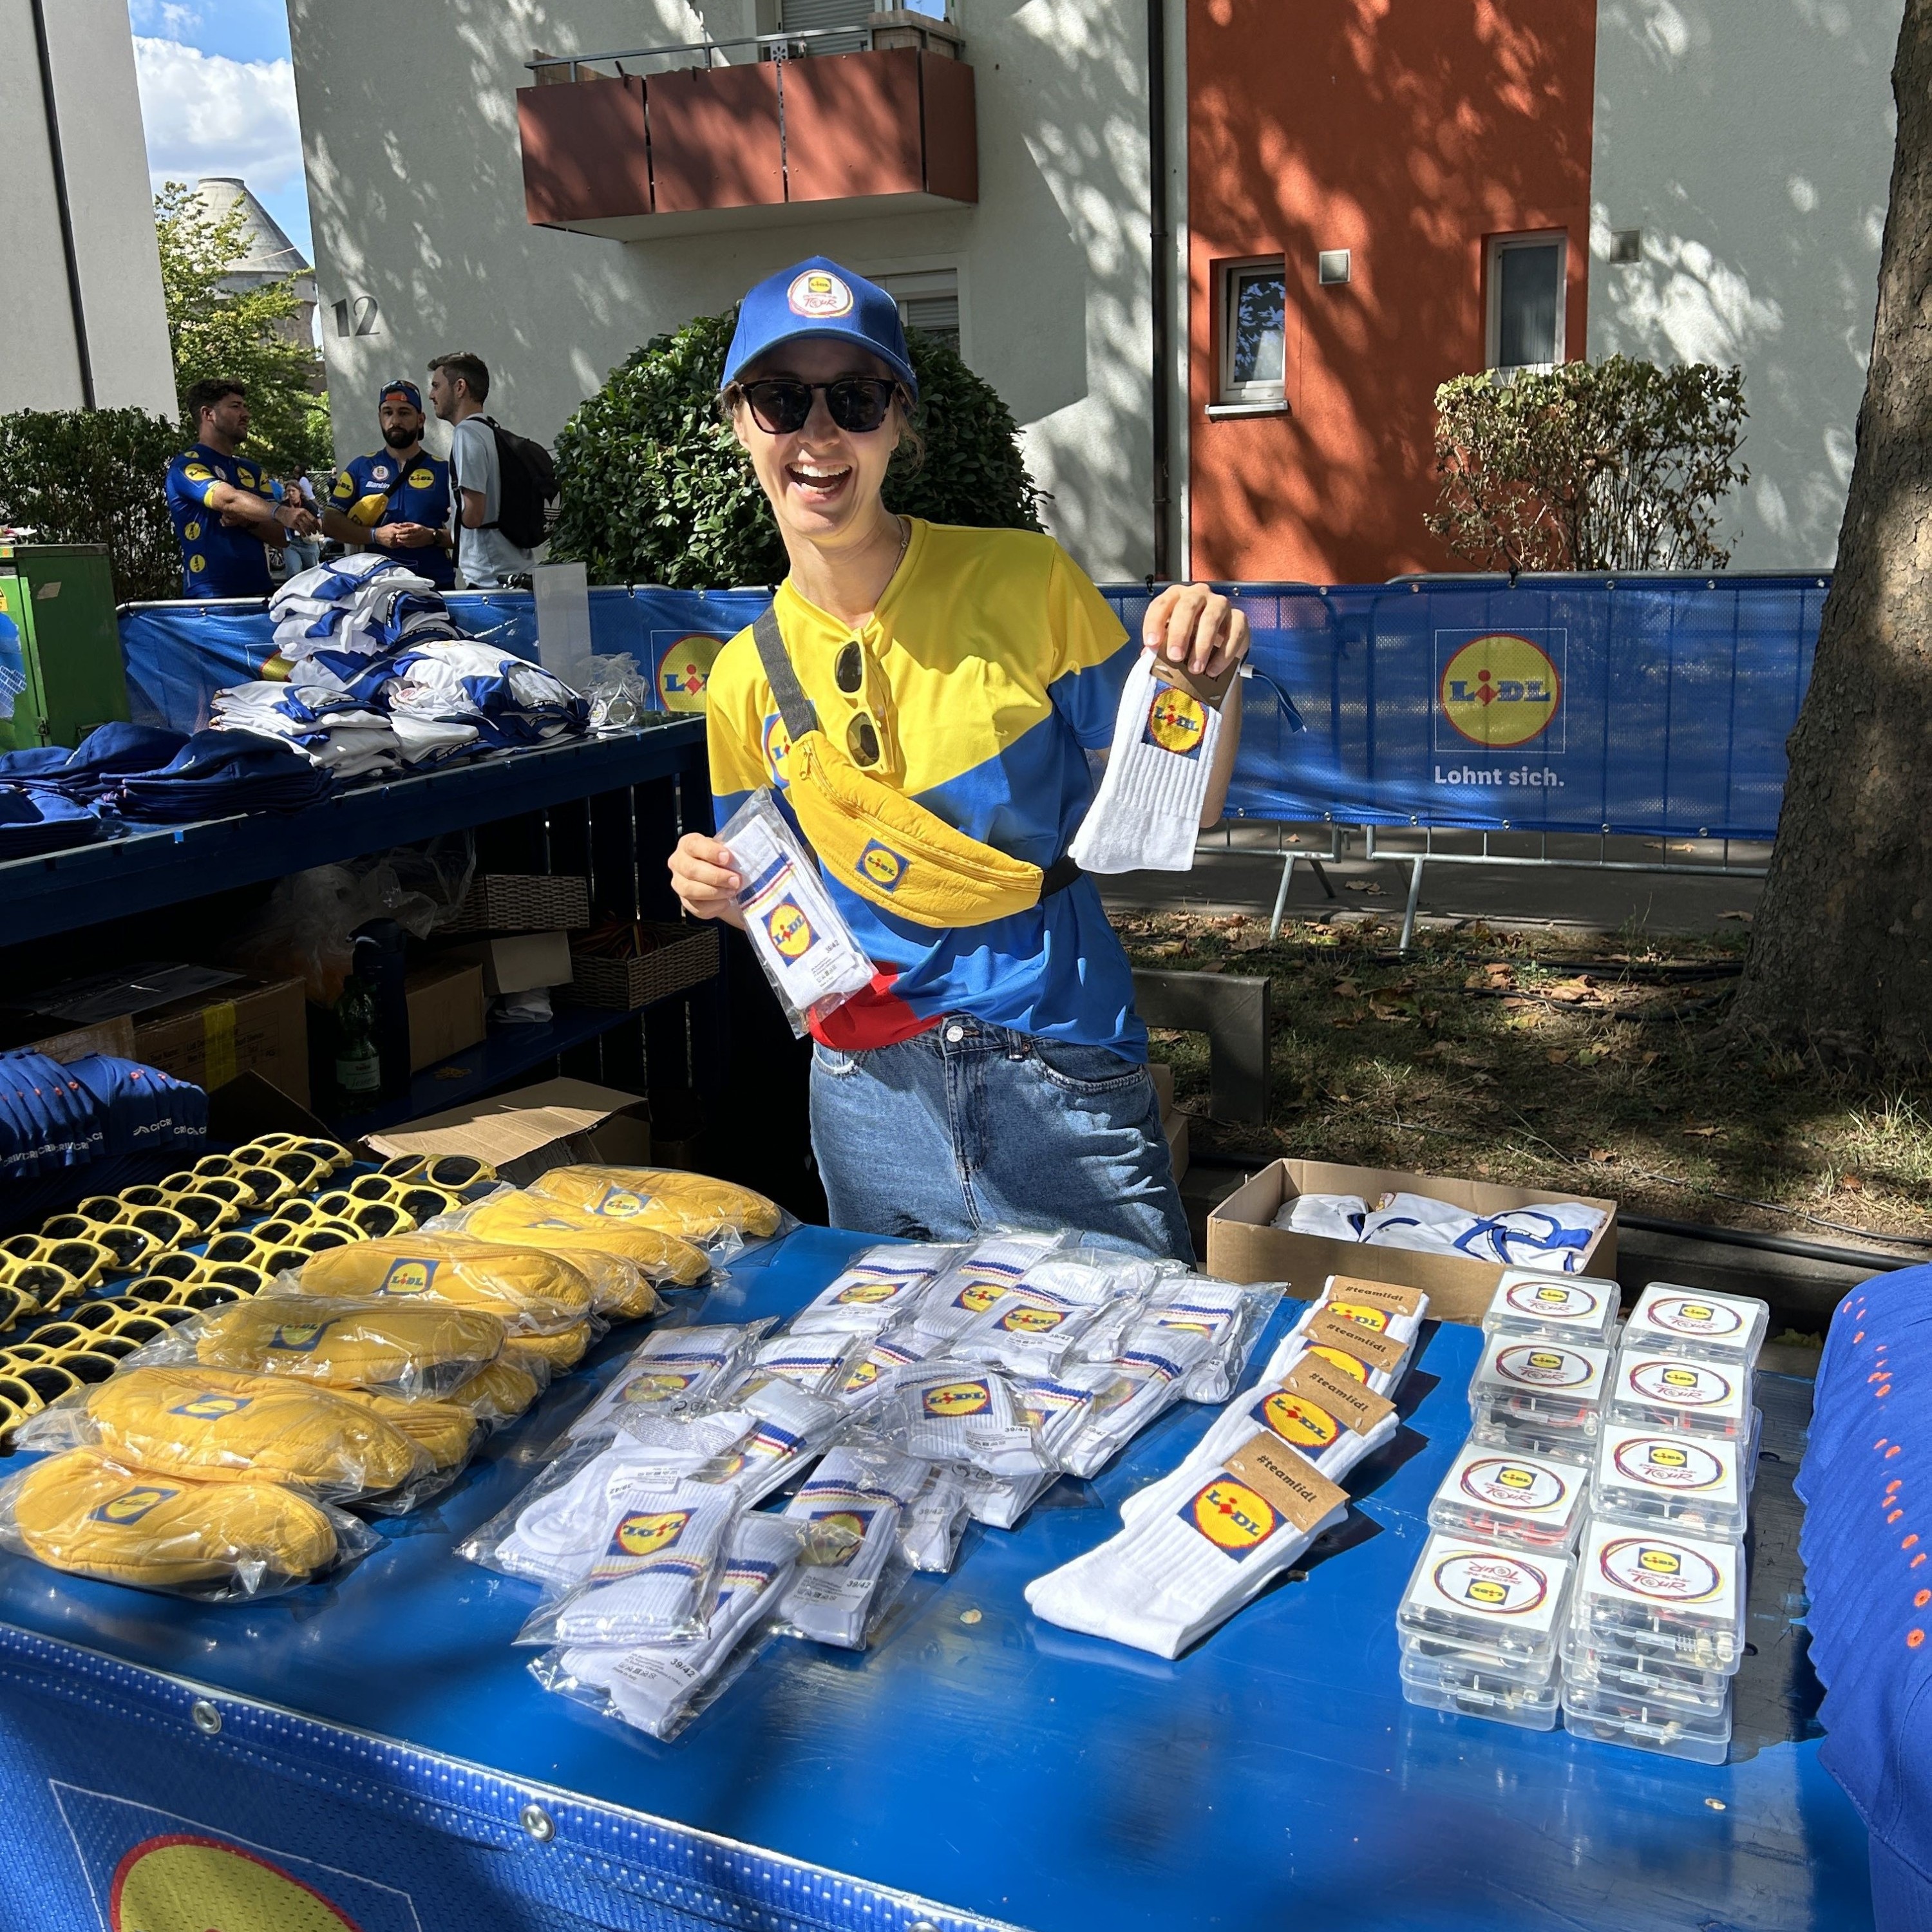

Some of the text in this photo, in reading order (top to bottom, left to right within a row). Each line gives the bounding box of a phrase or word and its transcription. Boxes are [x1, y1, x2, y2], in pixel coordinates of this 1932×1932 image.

[330, 297, 380, 337] 12
[1434, 766, 1564, 787] Lohnt sich.
[1345, 1285, 1404, 1302] #teamlidl
[1327, 1322, 1387, 1353] #teamlidl
[1309, 1372, 1369, 1412] #teamlidl
[1256, 1455, 1317, 1503] #teamlidl
[670, 1658, 696, 1678] 39/42
